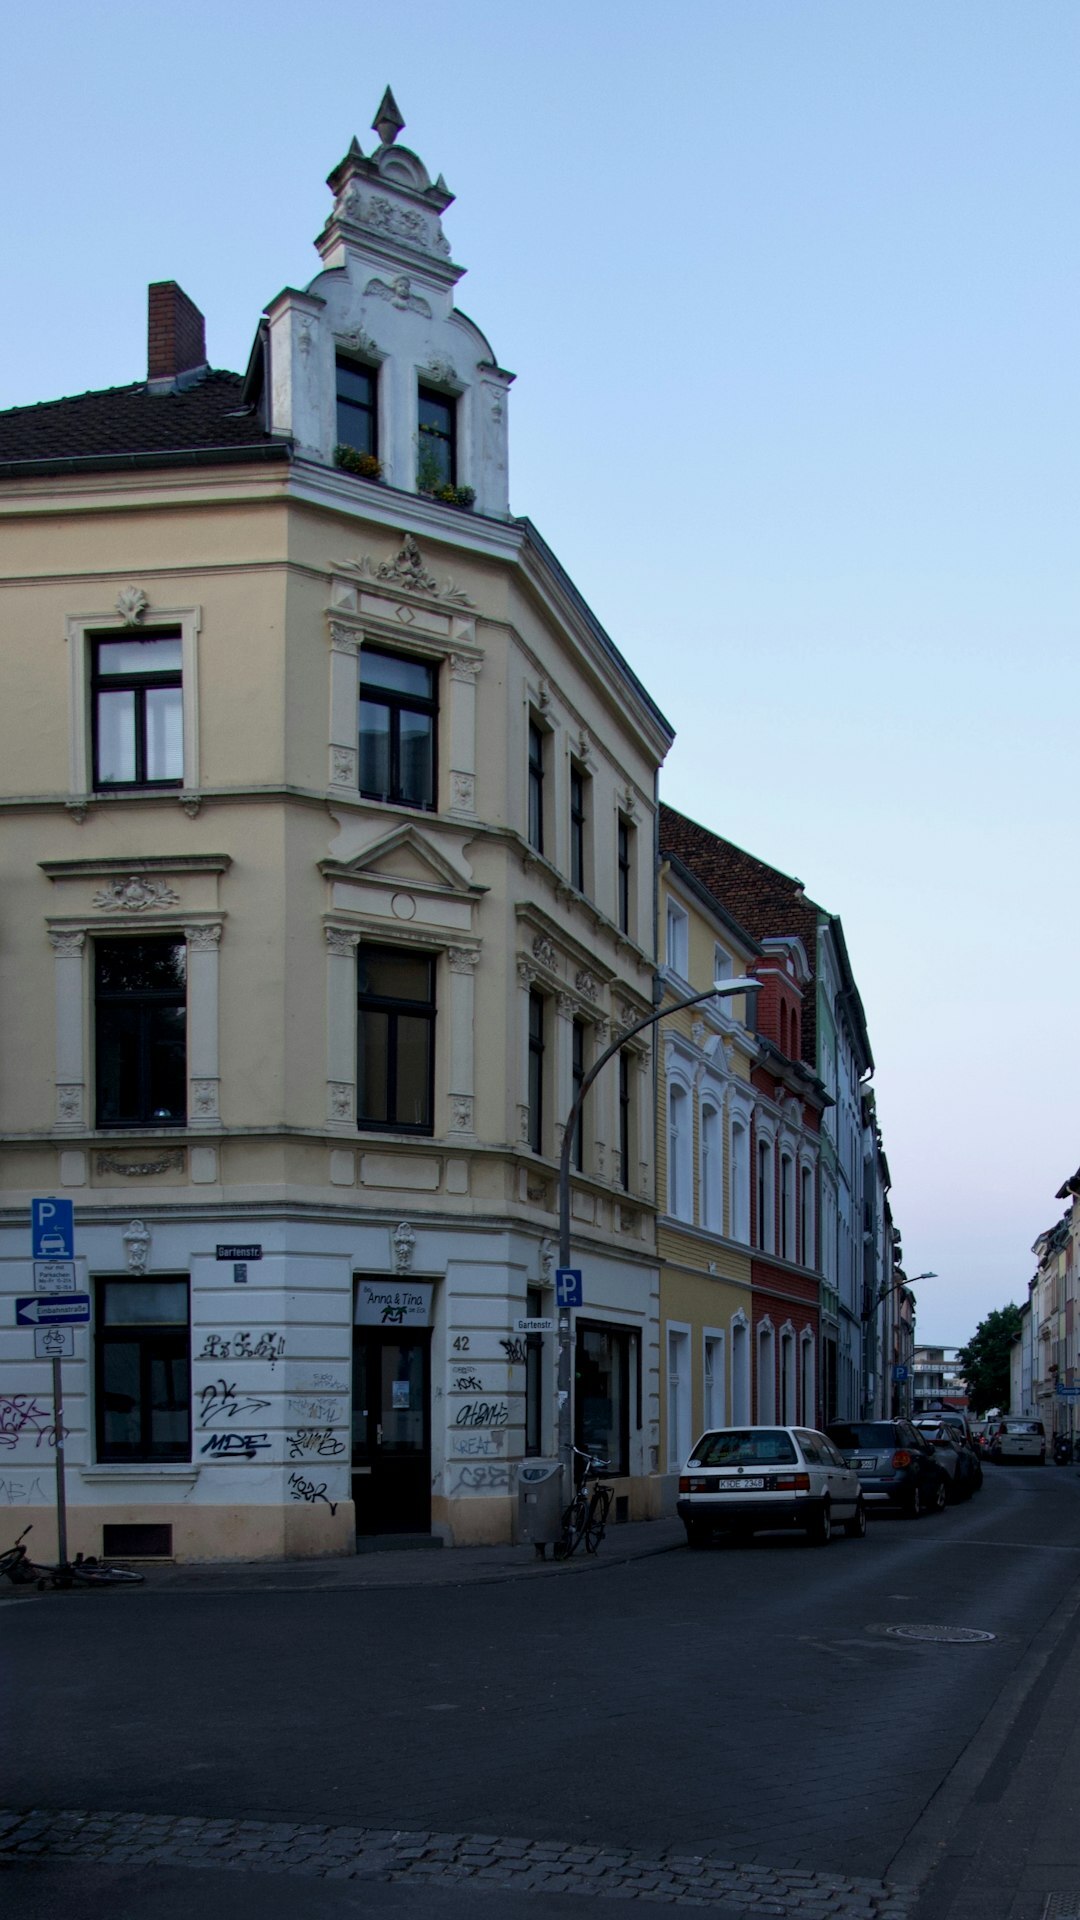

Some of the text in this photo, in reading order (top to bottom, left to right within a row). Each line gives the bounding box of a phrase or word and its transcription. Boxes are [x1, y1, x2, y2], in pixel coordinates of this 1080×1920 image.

[38, 1202, 56, 1226] P
[218, 1247, 260, 1257] Gartenstr.
[562, 1273, 577, 1303] P
[367, 1292, 423, 1306] Anna & Tina
[36, 1304, 87, 1315] Einbahnstraße
[518, 1320, 553, 1329] Gartenstr.
[453, 1336, 470, 1351] 42
[896, 1367, 905, 1379] P
